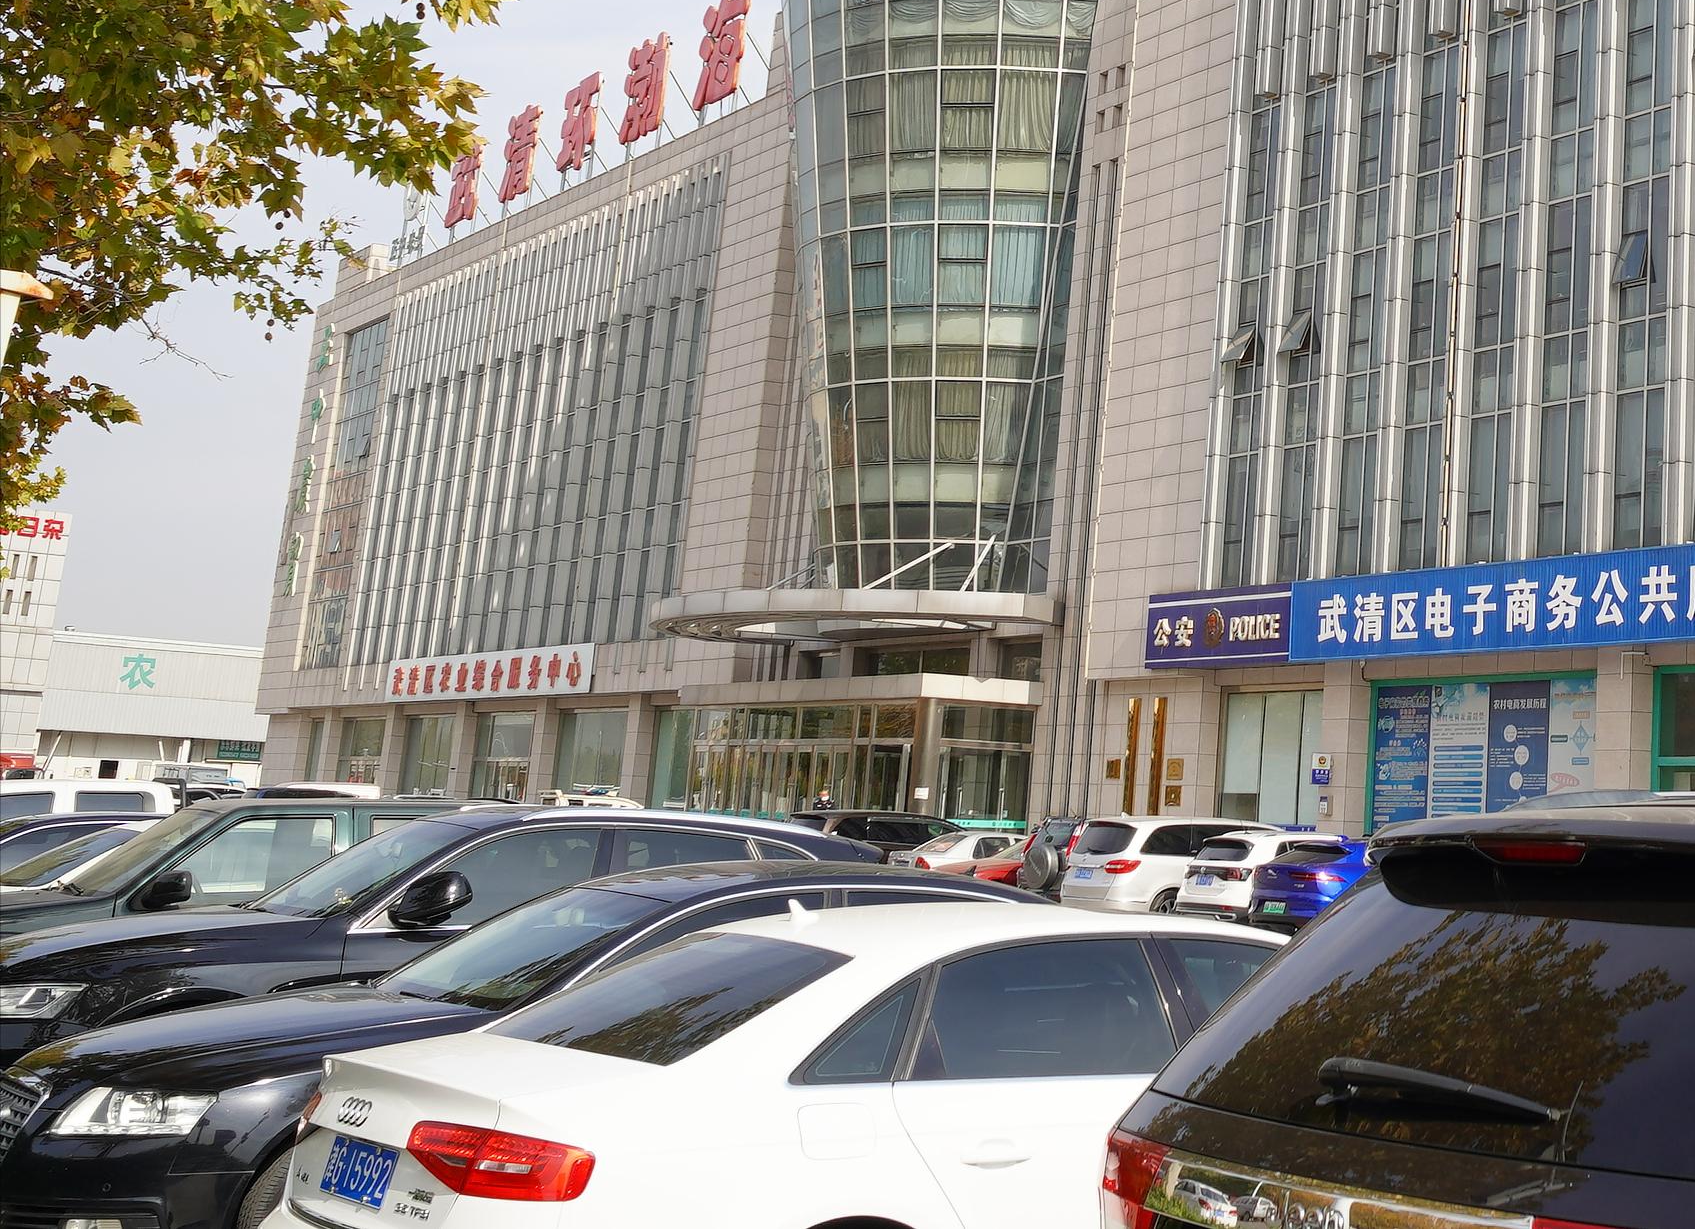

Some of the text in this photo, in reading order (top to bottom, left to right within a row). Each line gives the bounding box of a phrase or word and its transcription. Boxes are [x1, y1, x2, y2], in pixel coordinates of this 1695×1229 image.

[1153, 616, 1194, 647] 公安
[1229, 613, 1281, 642] POLICE
[119, 653, 156, 690] 农
[392, 650, 582, 697] 武清区农业综合服务中心
